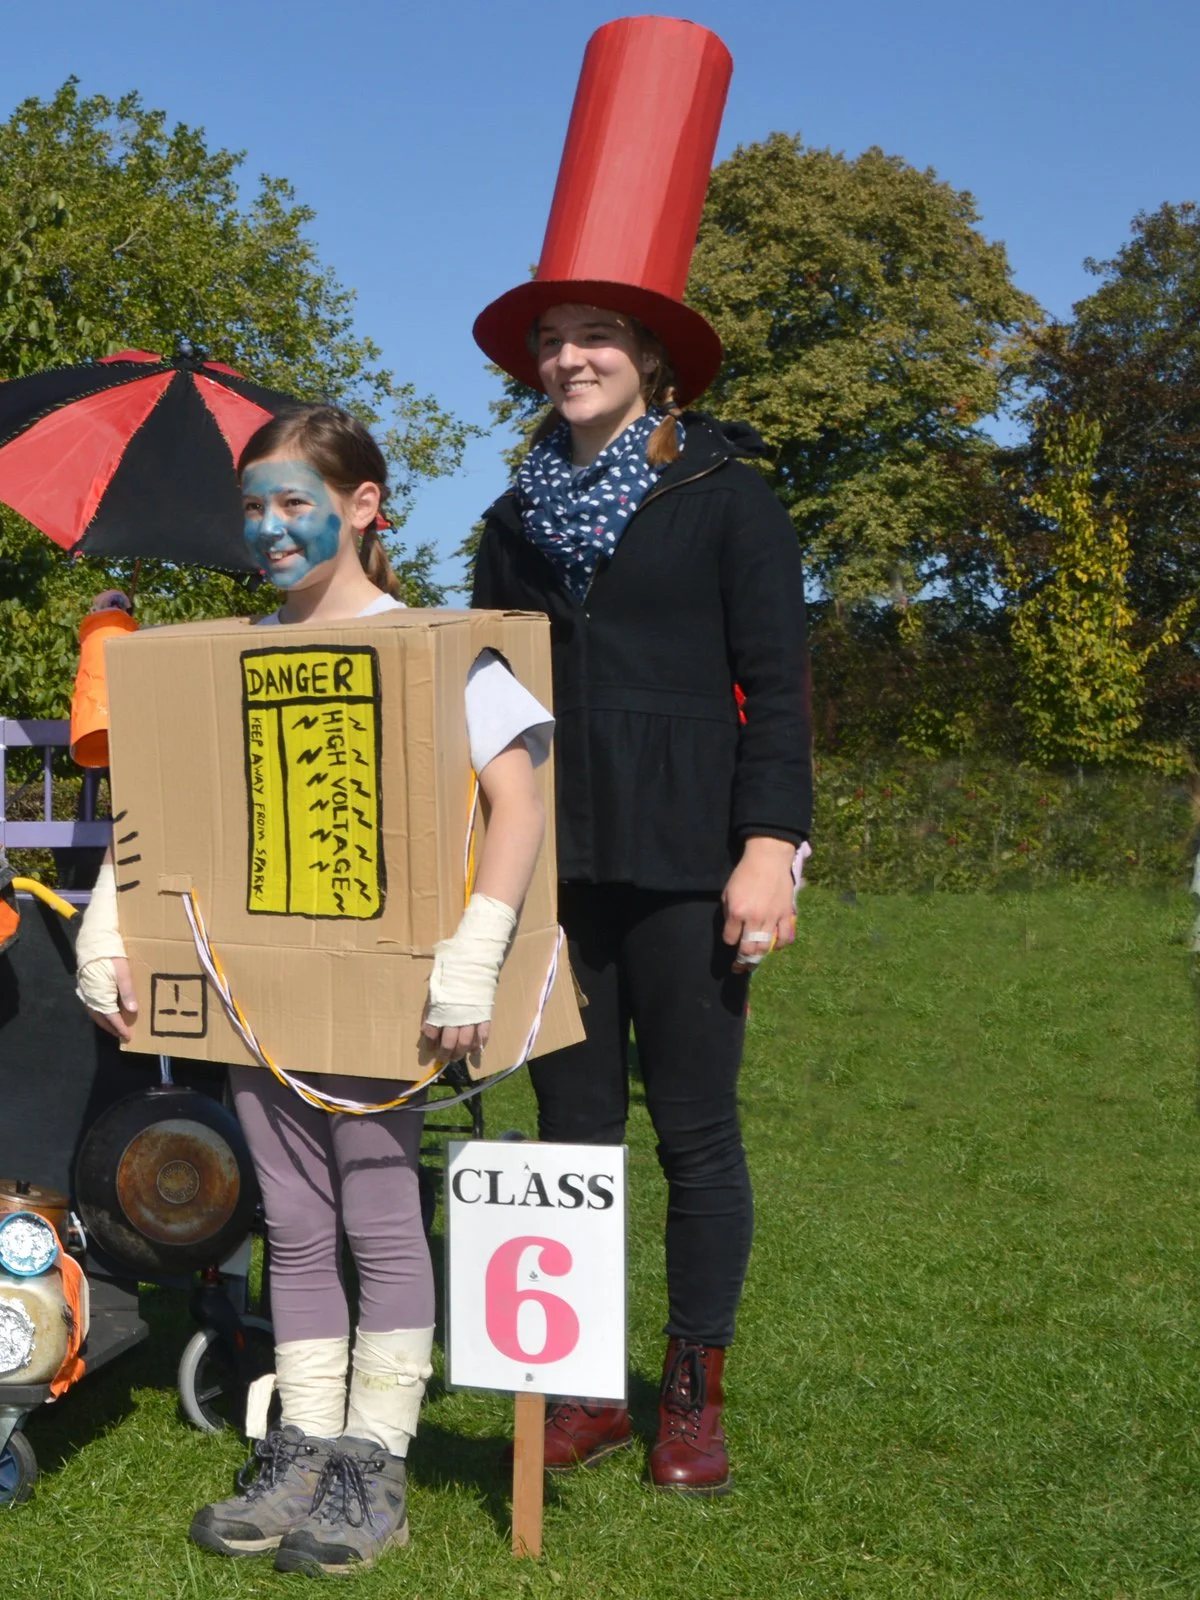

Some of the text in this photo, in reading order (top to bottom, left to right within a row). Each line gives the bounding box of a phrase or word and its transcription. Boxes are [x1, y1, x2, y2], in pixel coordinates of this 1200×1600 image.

[247, 656, 354, 696] DANGER
[251, 717, 264, 748] KEEP
[251, 753, 264, 795] AWAY
[254, 802, 266, 841] FROM
[321, 709, 352, 892] HIGH VOLTAGE
[452, 1168, 615, 1210] CLASS
[485, 1235, 580, 1365] 6
